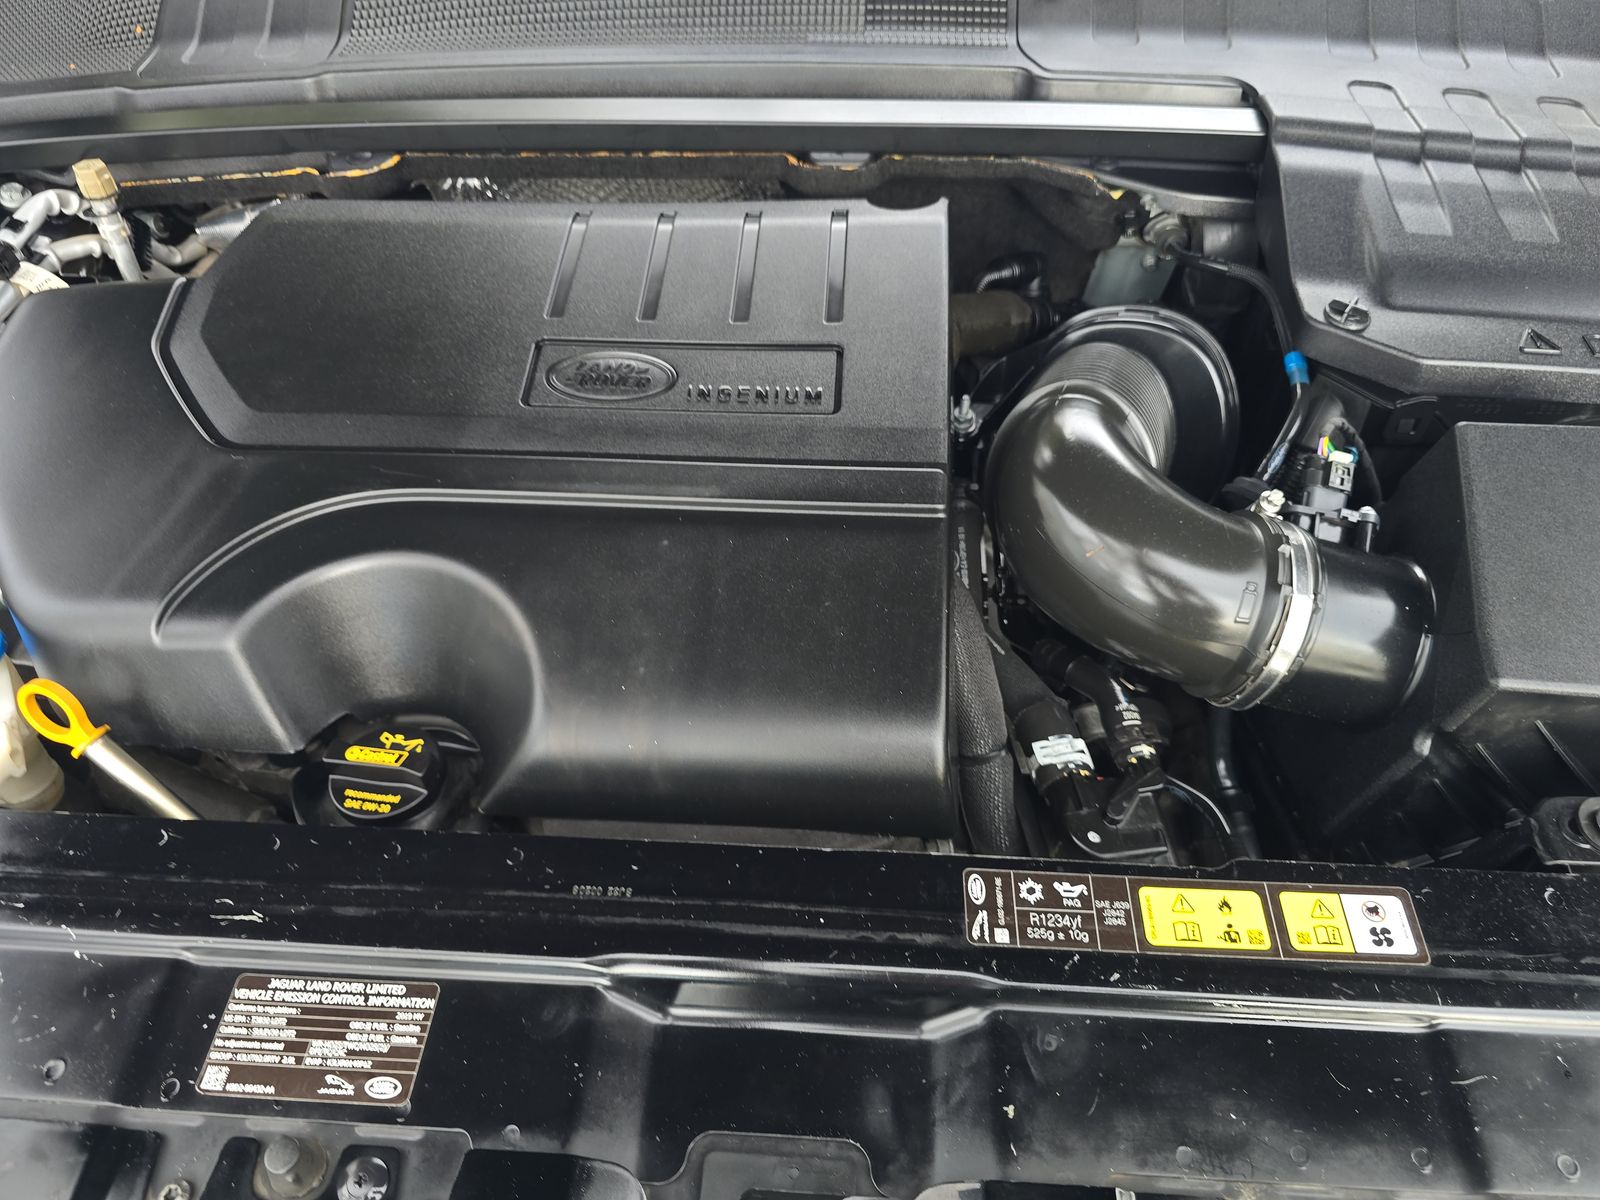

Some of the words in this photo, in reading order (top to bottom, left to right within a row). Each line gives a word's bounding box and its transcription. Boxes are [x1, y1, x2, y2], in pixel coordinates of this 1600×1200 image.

[686, 384, 824, 405] INGENIUM
[1062, 898, 1082, 908] PAG
[1095, 899, 1111, 909] SAE
[1029, 912, 1083, 929] R1234yf
[1026, 927, 1055, 942] 525g
[1069, 930, 1090, 943] 10g
[268, 978, 305, 991] JAGUAR
[306, 980, 332, 992] LAND
[333, 981, 366, 994] ROVER
[366, 983, 406, 996] LIMITED
[234, 988, 274, 1001] VEHICLE
[274, 990, 321, 1004] EMISSION
[321, 993, 366, 1006] CONTROL
[367, 995, 435, 1009] INFORMATION
